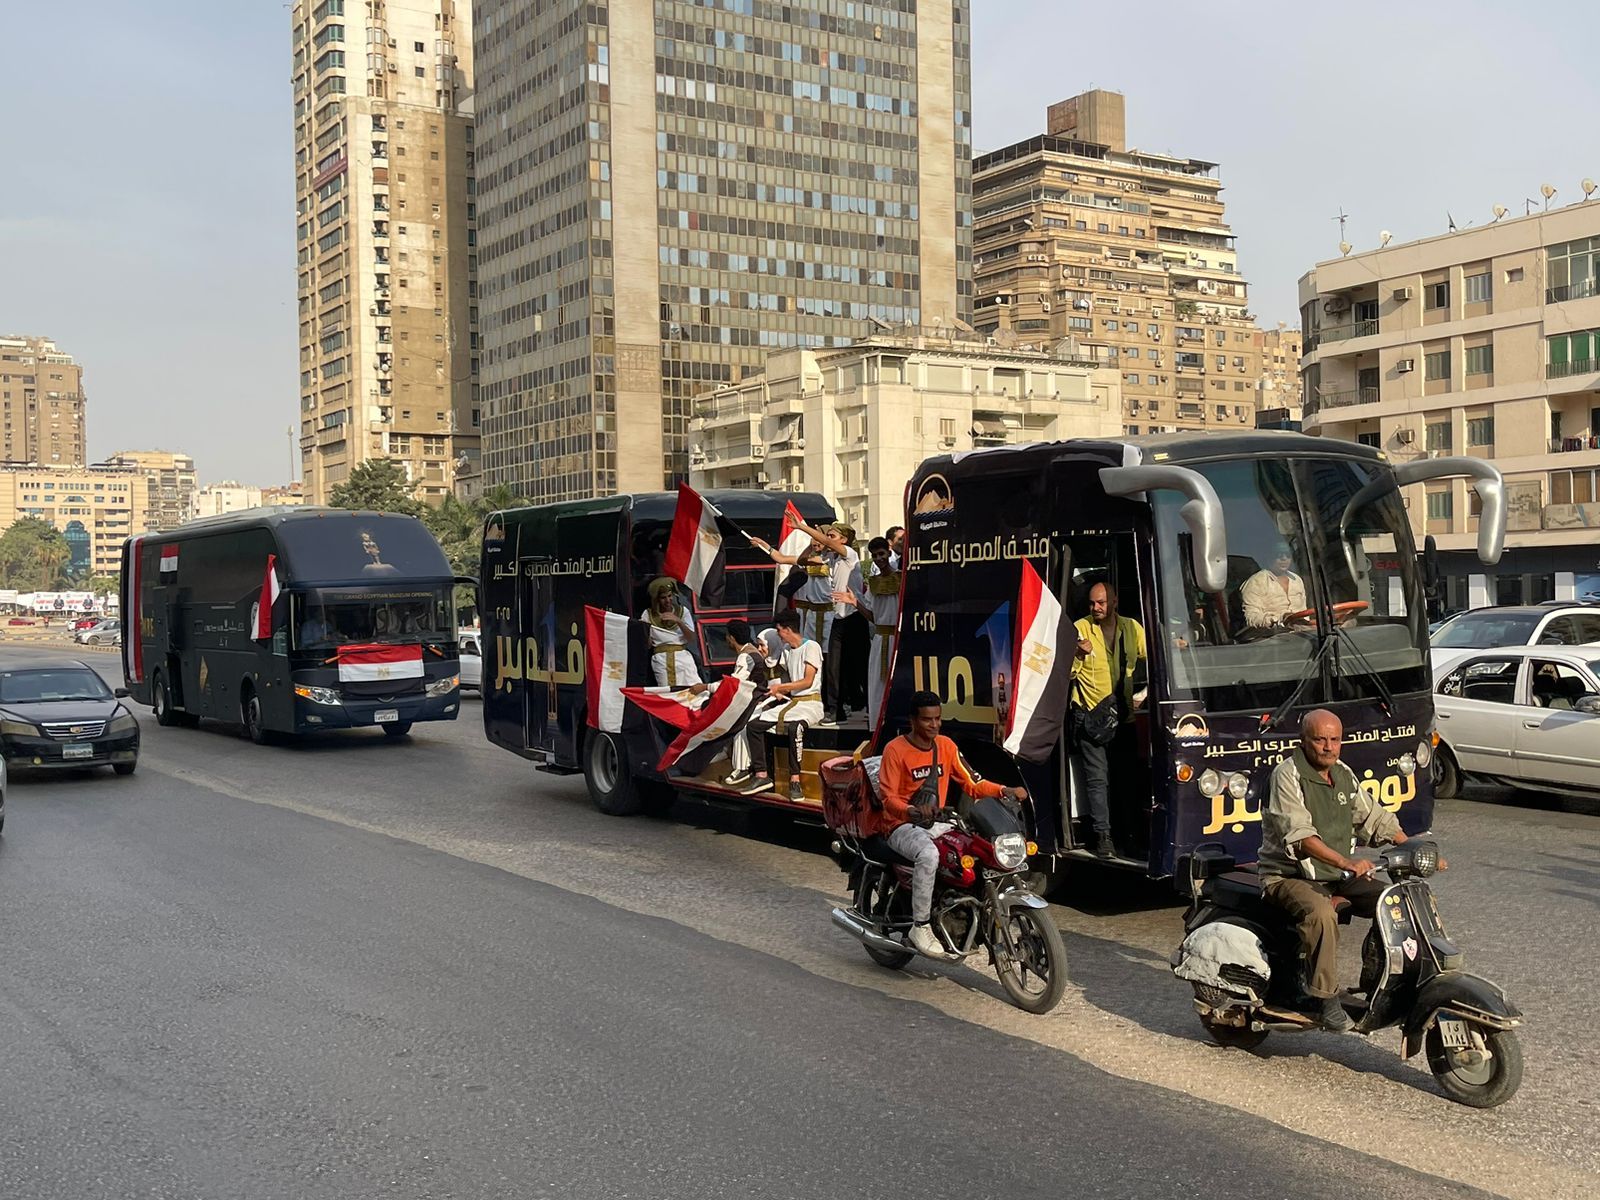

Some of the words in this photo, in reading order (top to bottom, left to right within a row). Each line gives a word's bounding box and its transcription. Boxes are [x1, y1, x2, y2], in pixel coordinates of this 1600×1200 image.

[907, 539, 948, 570] الكبير
[585, 555, 614, 577] افتتاح
[1381, 725, 1416, 742] افتتاح
[1203, 740, 1261, 758] الكبير
